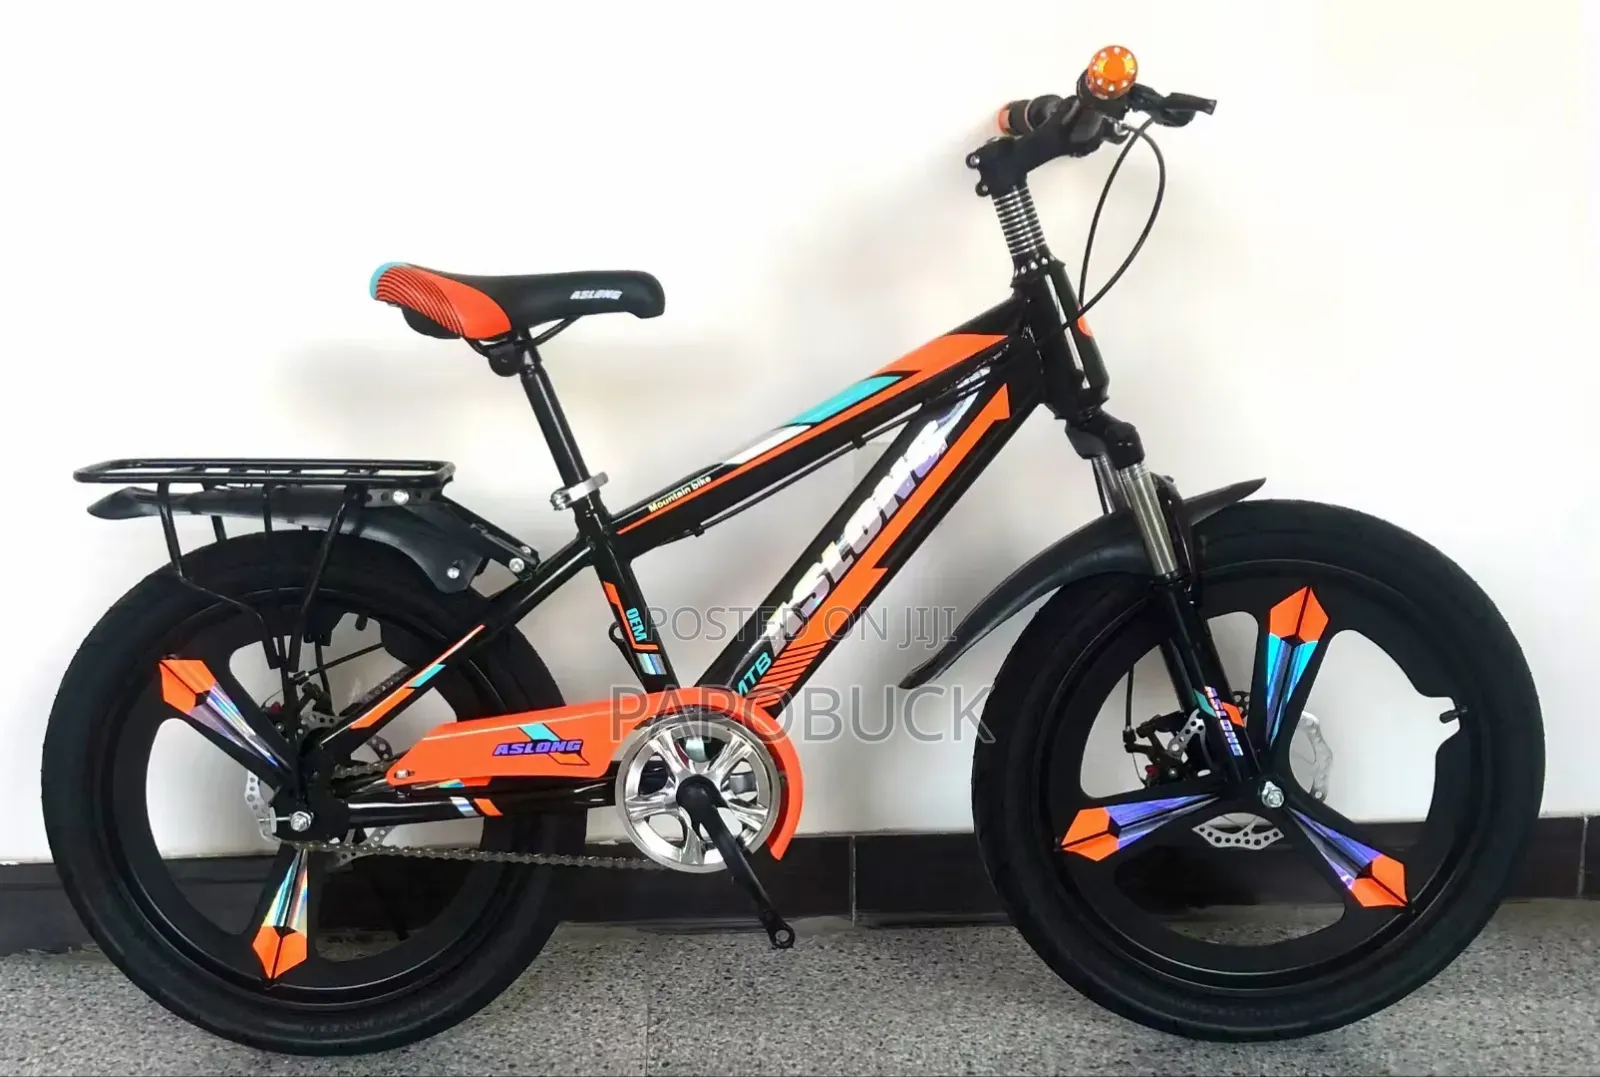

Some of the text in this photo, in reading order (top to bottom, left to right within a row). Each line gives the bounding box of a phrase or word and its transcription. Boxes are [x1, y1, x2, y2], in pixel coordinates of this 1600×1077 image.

[648, 476, 712, 513] Mountain bike
[626, 607, 647, 642] OEM
[493, 739, 583, 756] ASLONG
